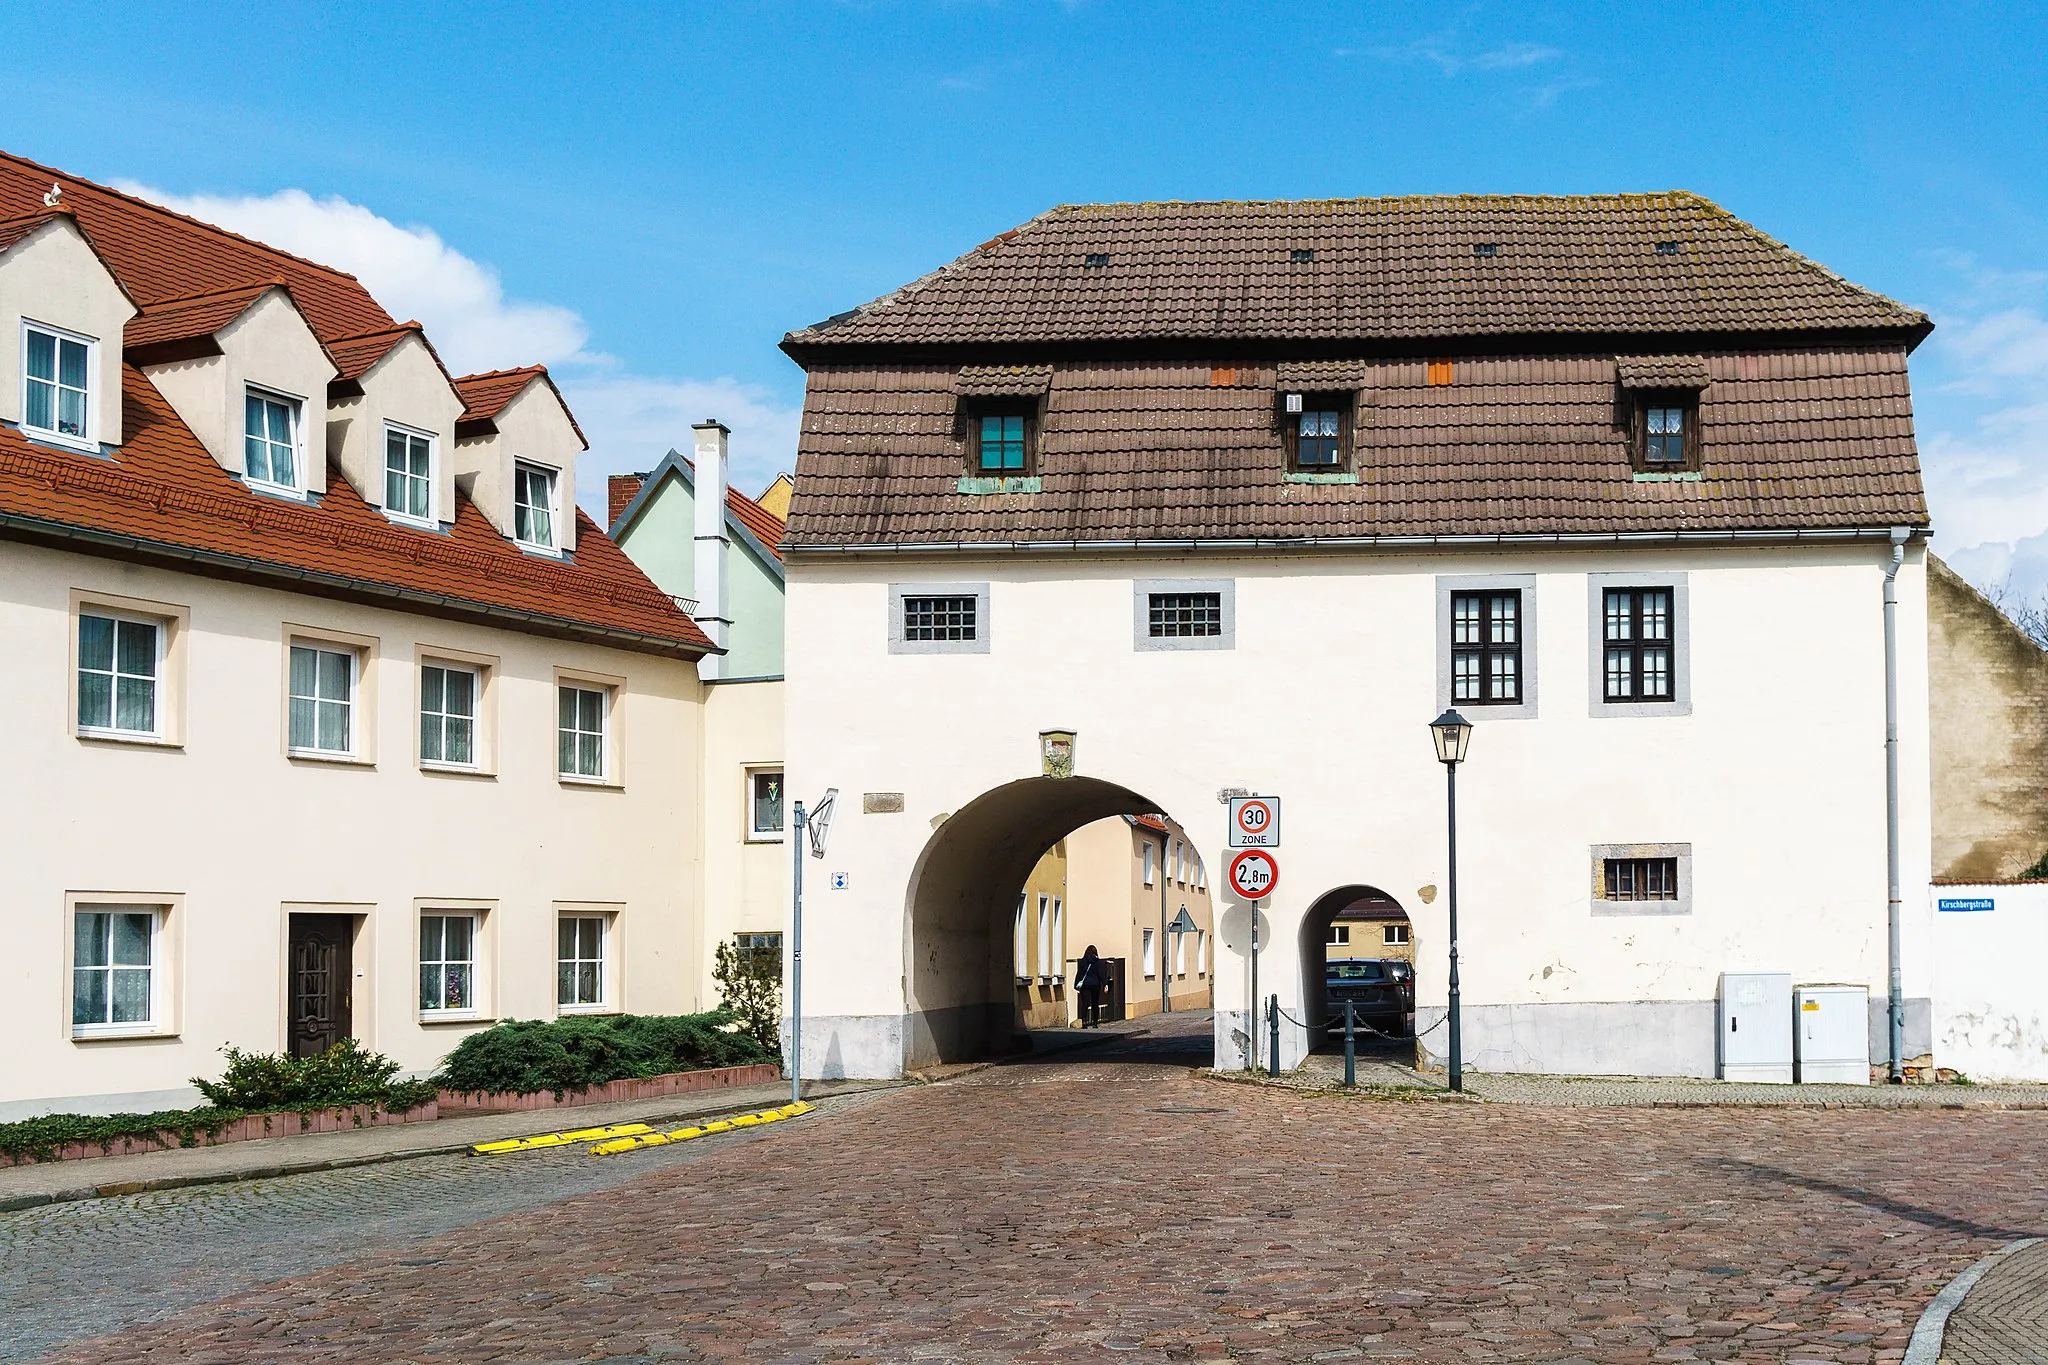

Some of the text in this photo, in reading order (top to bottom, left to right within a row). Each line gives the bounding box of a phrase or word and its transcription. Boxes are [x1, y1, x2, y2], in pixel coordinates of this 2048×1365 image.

[1245, 810, 1264, 825] 30
[1242, 835, 1267, 844] ZONE
[1238, 864, 1269, 884] 2,8m
[1941, 900, 1992, 910] Kirschbergstraße
